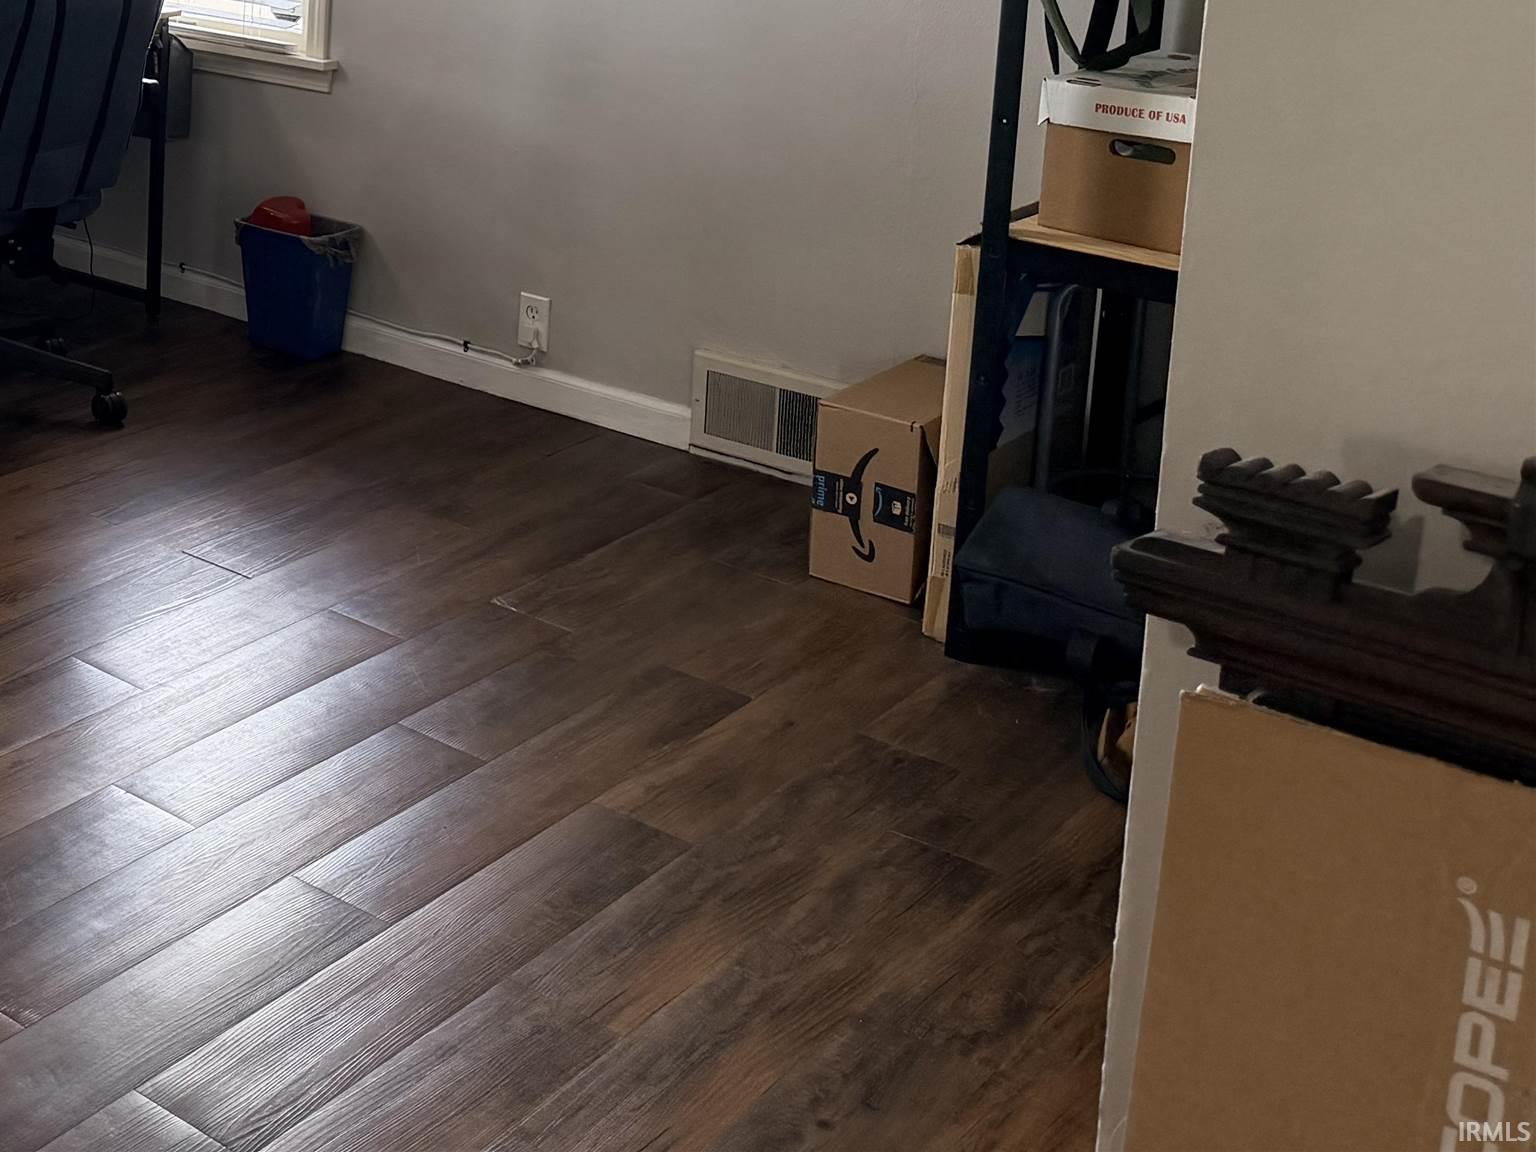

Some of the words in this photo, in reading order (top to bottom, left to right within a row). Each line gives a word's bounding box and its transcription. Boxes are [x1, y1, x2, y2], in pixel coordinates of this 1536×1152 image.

[1095, 103, 1145, 119] PRODUCE
[1148, 110, 1163, 121] OF
[1165, 112, 1187, 125] USA
[815, 475, 828, 507] prime
